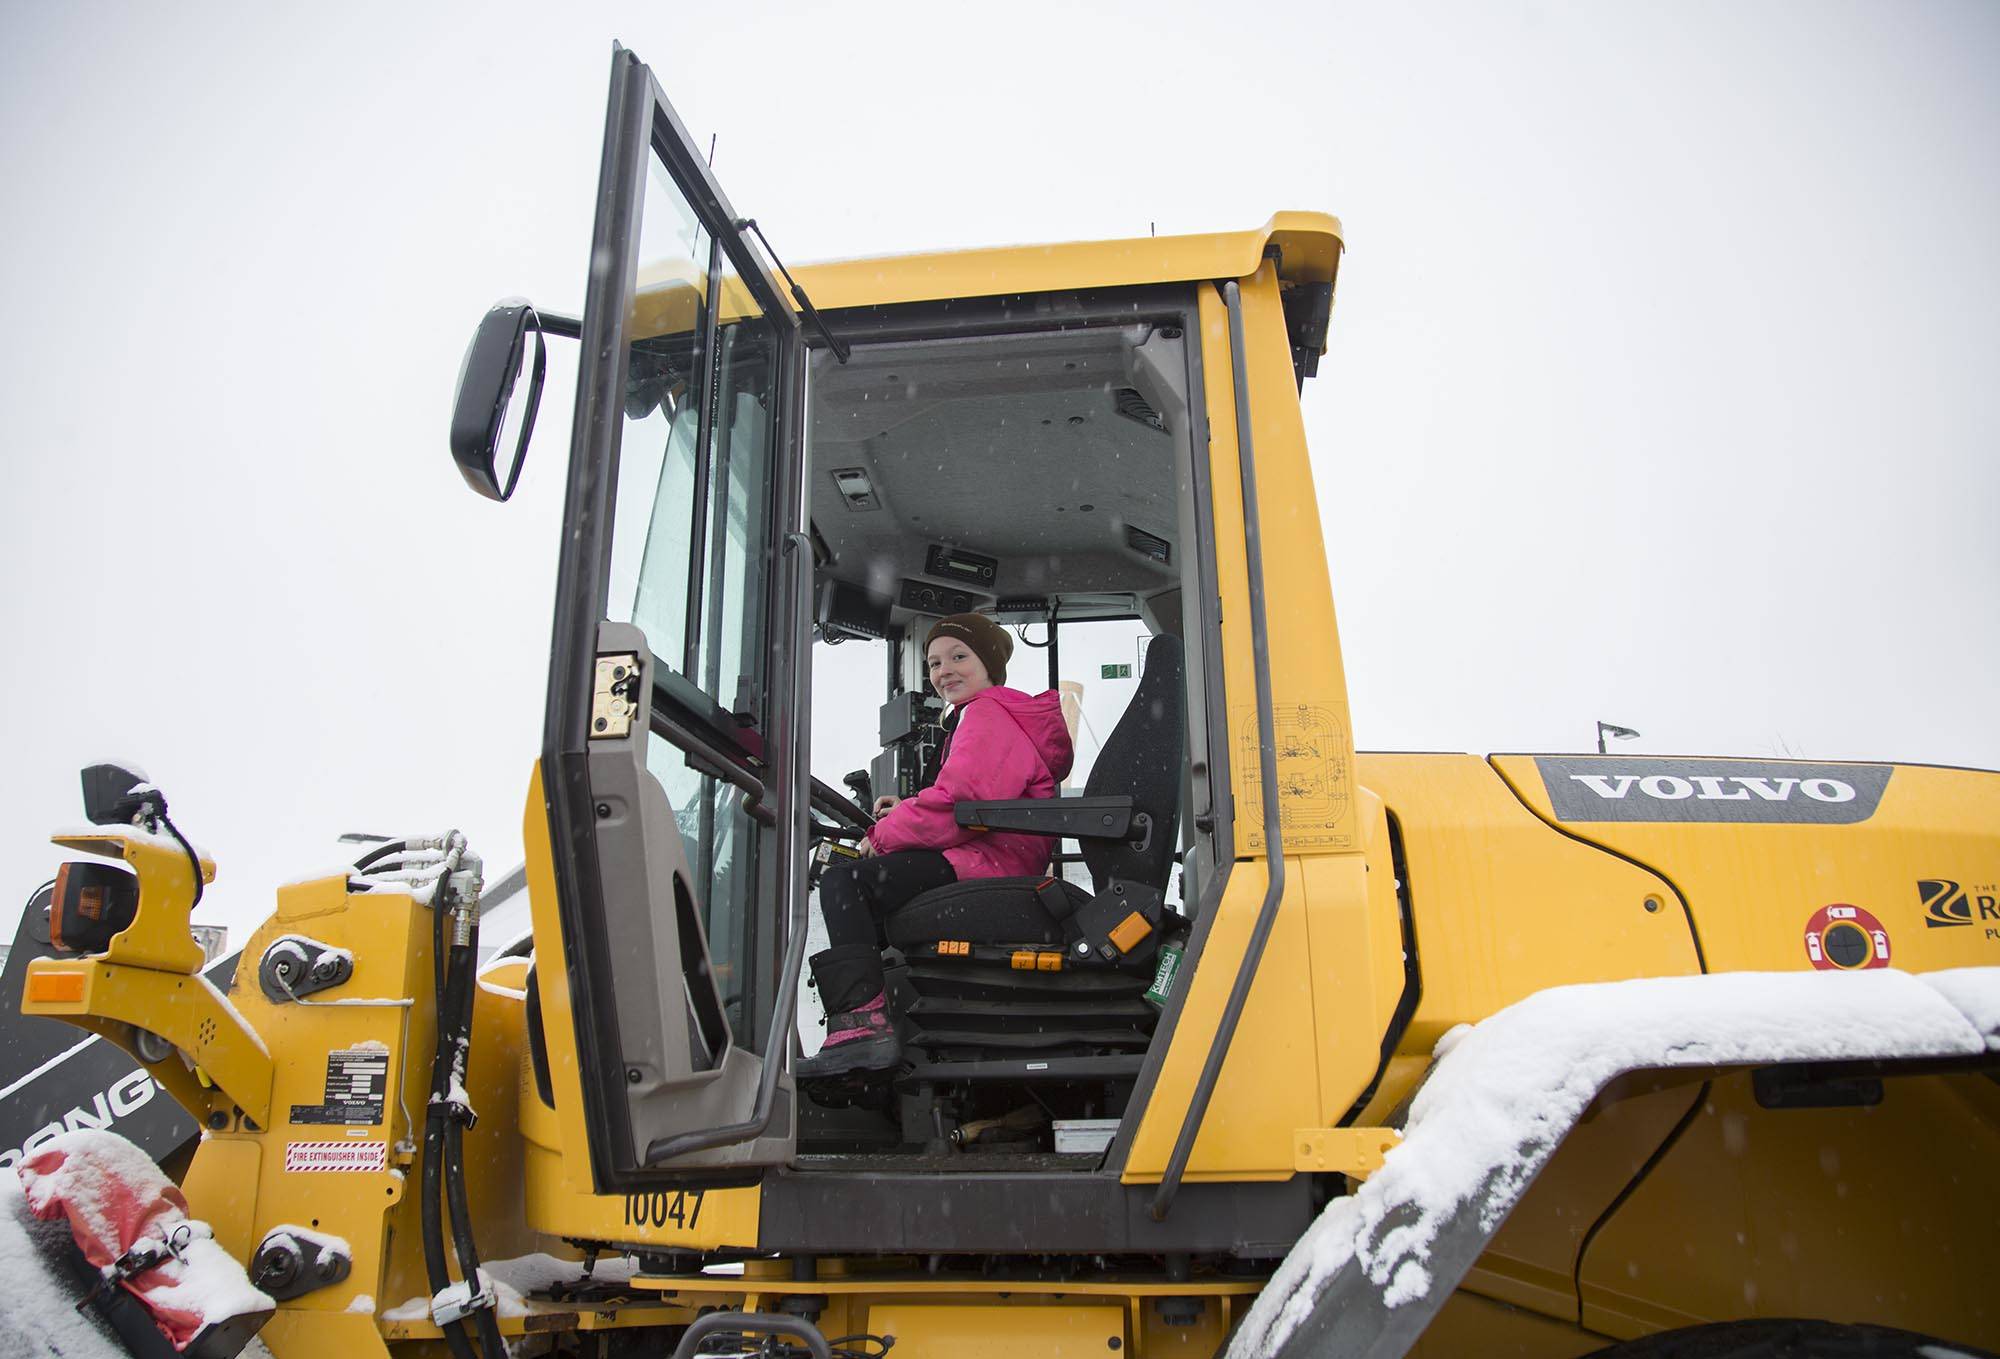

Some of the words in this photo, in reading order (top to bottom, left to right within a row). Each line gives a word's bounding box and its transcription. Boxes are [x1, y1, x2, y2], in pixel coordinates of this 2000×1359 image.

[1570, 775, 1856, 802] VOLVO
[1974, 884, 1996, 893] THE
[1976, 895, 2000, 920] R
[1151, 952, 1173, 993] KIMTECH
[293, 1152, 307, 1162] FIRE
[309, 1152, 355, 1162] EXTINGUISHER
[357, 1152, 379, 1162] INSIDE
[625, 1189, 705, 1230] 10047
